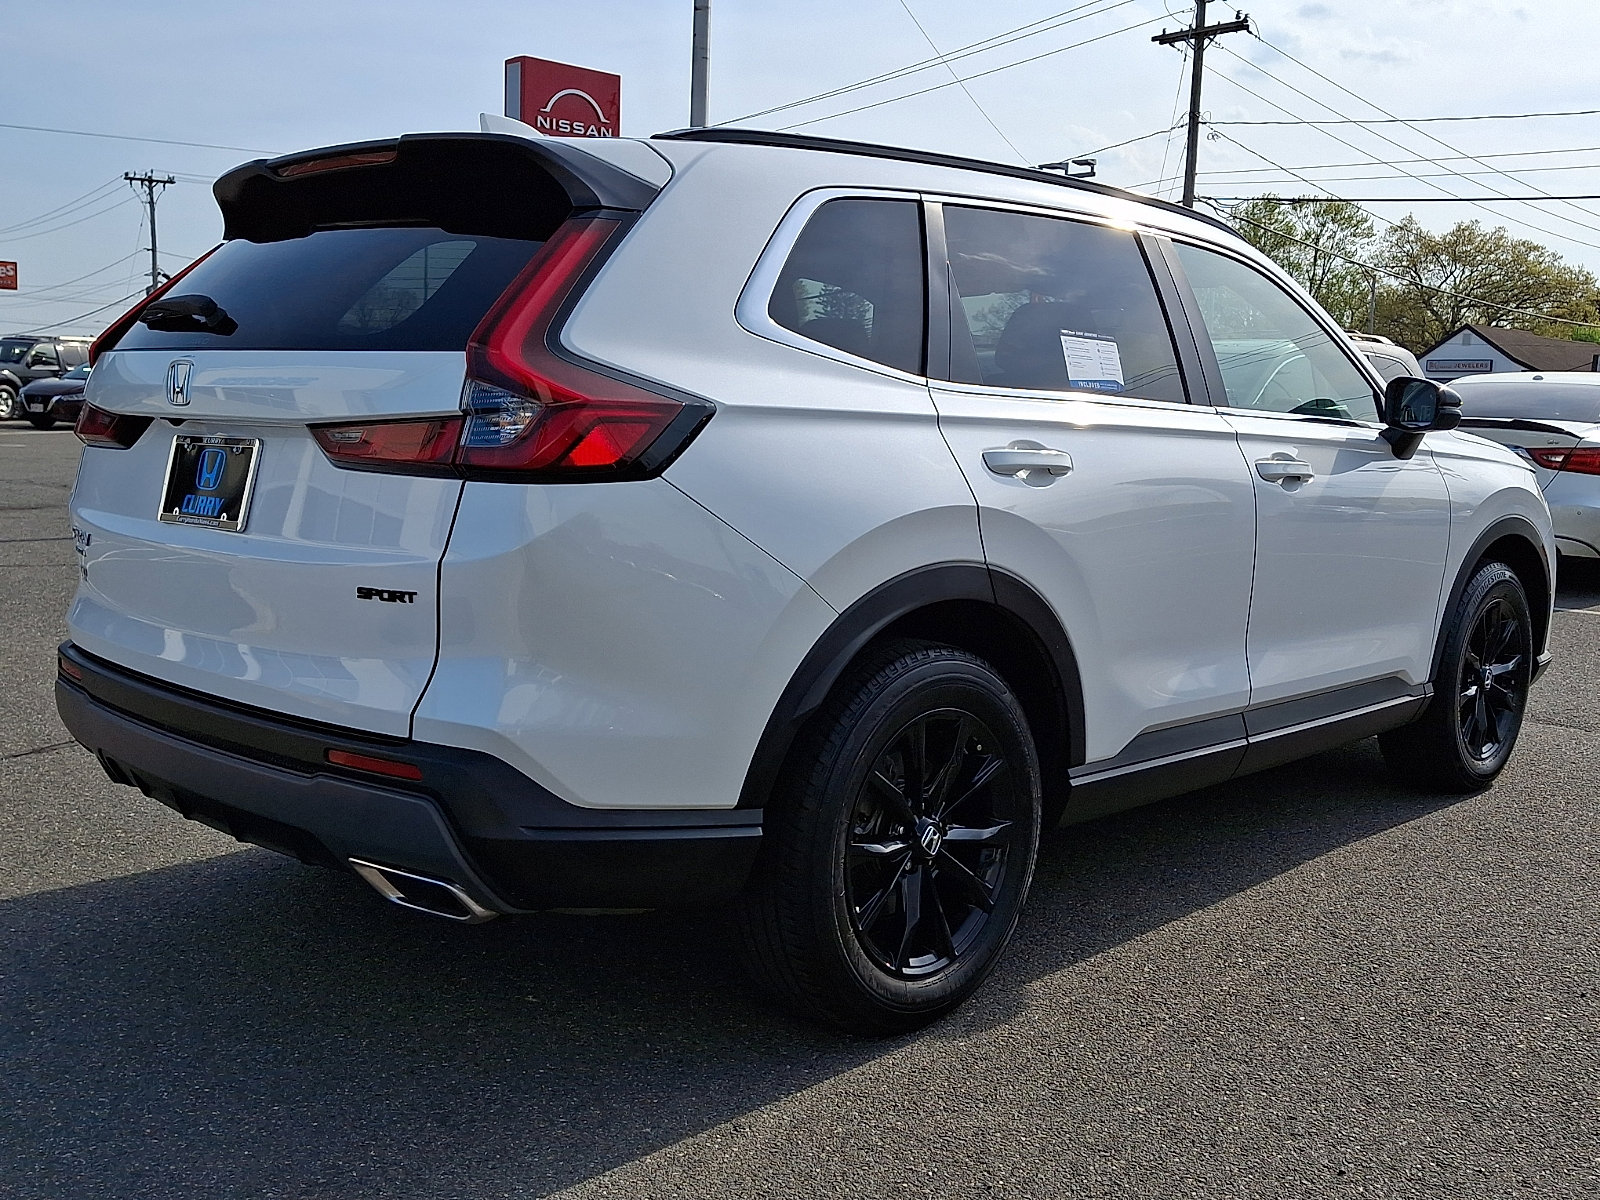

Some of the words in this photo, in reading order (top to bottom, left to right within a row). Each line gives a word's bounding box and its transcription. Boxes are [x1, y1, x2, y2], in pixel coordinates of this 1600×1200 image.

[537, 115, 612, 137] NISSAN
[182, 494, 224, 516] CURRY
[357, 586, 418, 604] SPORT
